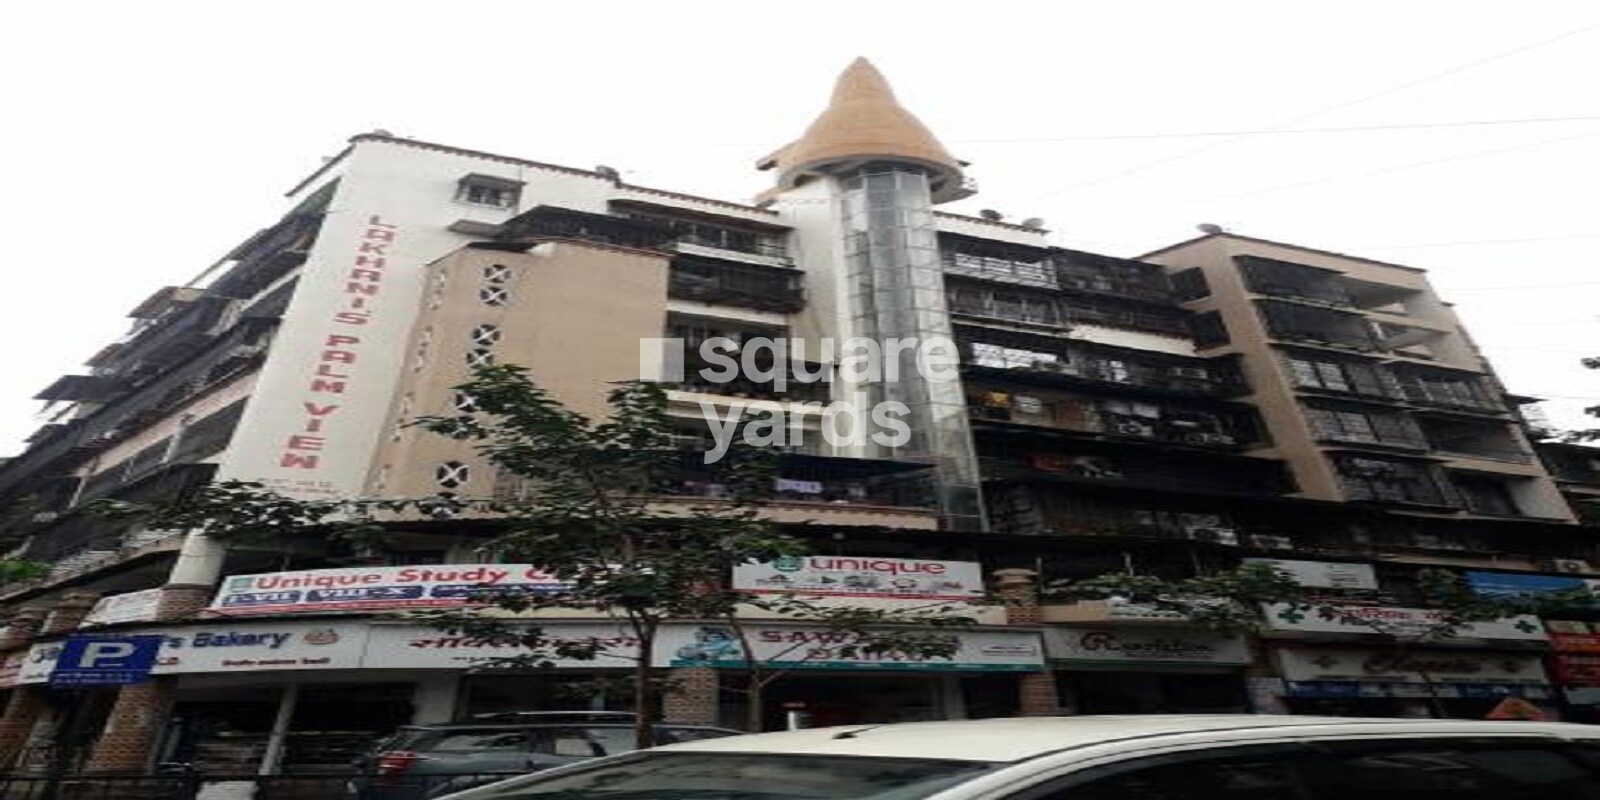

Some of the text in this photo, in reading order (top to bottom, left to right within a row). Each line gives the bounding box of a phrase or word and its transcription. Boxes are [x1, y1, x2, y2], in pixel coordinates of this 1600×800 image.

[310, 334, 361, 393] PALM
[280, 401, 338, 468] VIEW
[256, 571, 381, 590] Unique
[395, 566, 507, 585] Study
[809, 557, 947, 576] unique
[192, 630, 292, 649] Bakery
[78, 642, 135, 669] P
